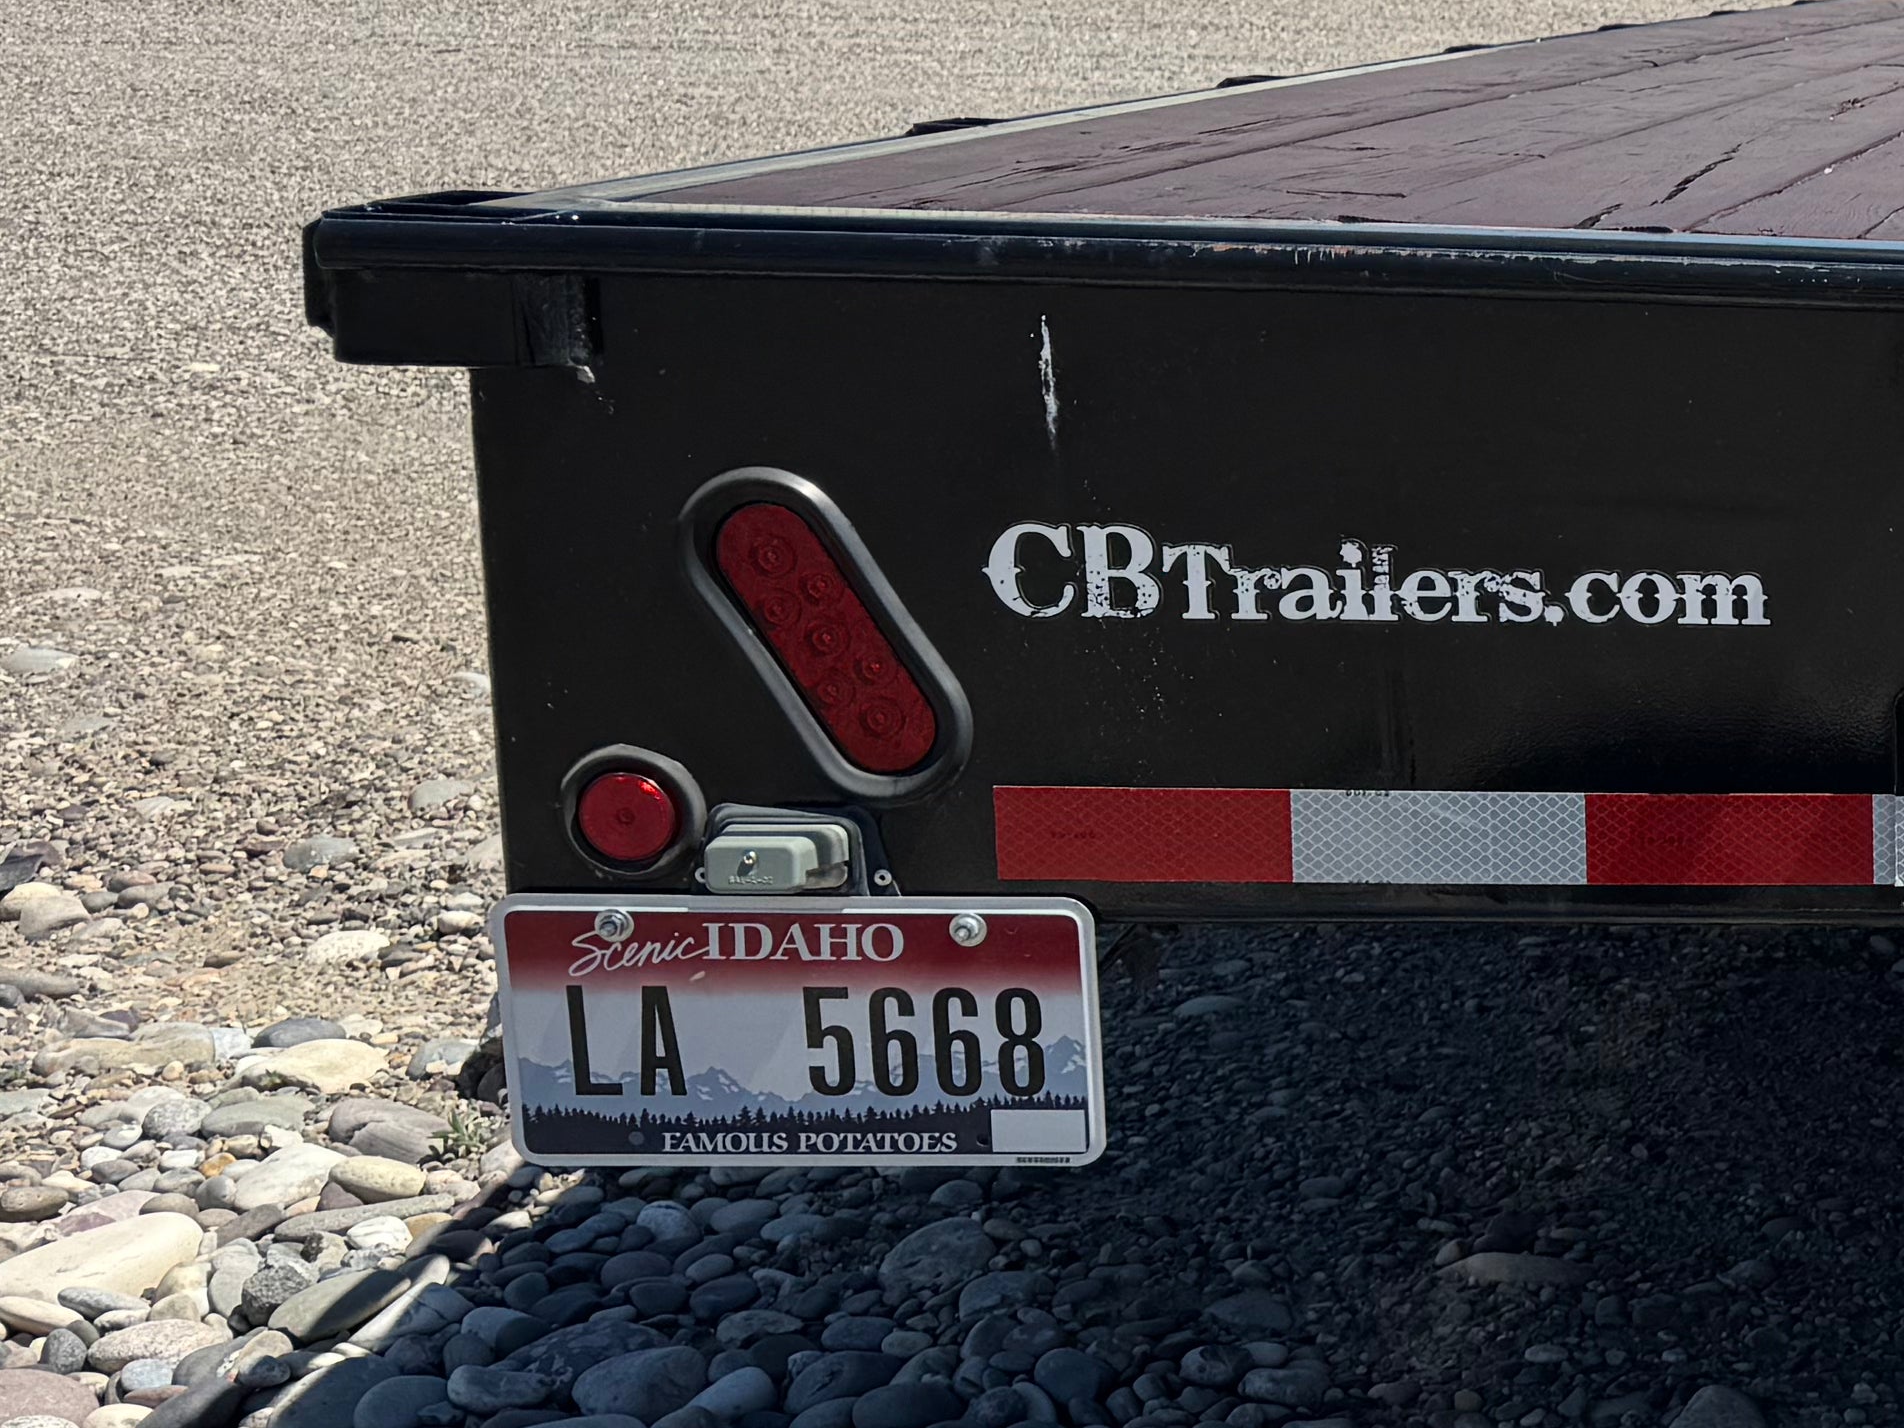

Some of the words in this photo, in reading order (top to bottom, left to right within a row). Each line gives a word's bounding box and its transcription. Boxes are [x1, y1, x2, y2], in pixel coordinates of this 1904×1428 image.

[982, 521, 1773, 626] CBTrailers.com
[568, 932, 711, 977] Scenic
[702, 922, 905, 963] IDAHO
[566, 984, 689, 1097] LA
[802, 986, 1047, 1097] 5668
[663, 1132, 789, 1154] FAMOUS
[798, 1132, 959, 1155] POTATOES
